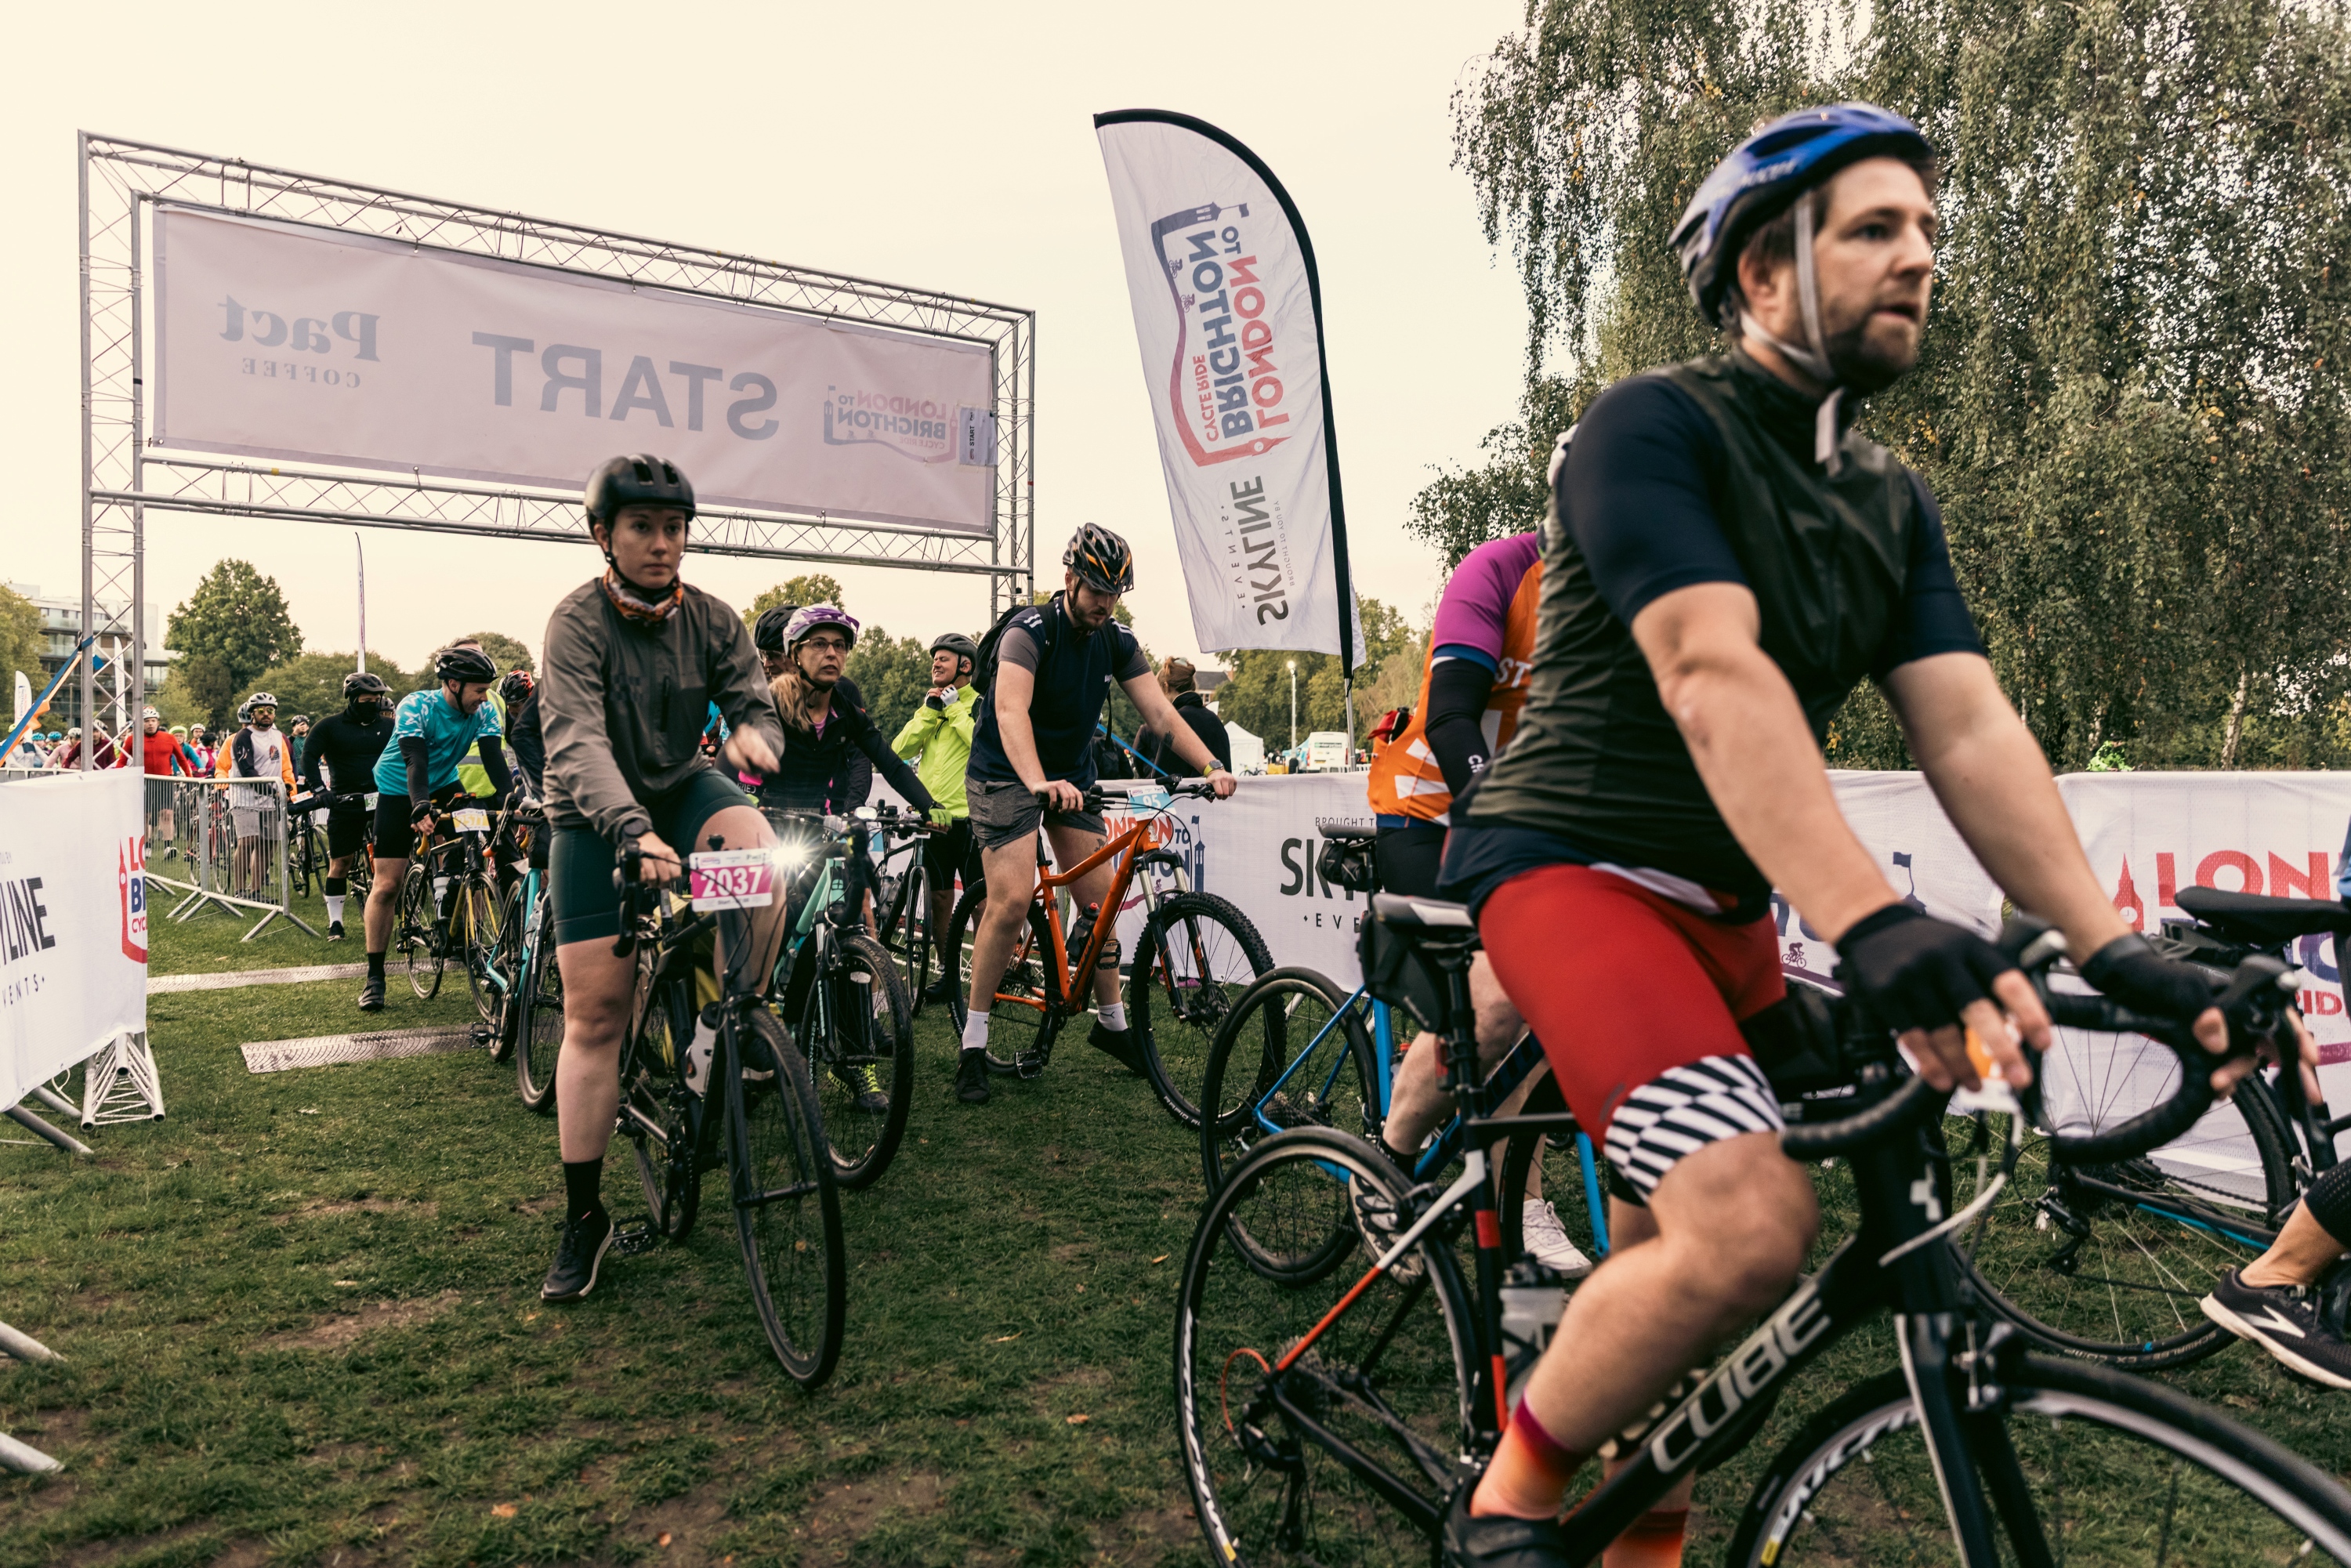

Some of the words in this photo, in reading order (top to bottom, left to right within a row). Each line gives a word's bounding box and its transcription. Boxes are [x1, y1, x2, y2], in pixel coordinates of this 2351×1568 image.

[1143, 794, 1161, 812] 95
[1175, 828, 1191, 845] TO
[700, 865, 765, 899] 2037
[1649, 1295, 1833, 1475] CUBE
